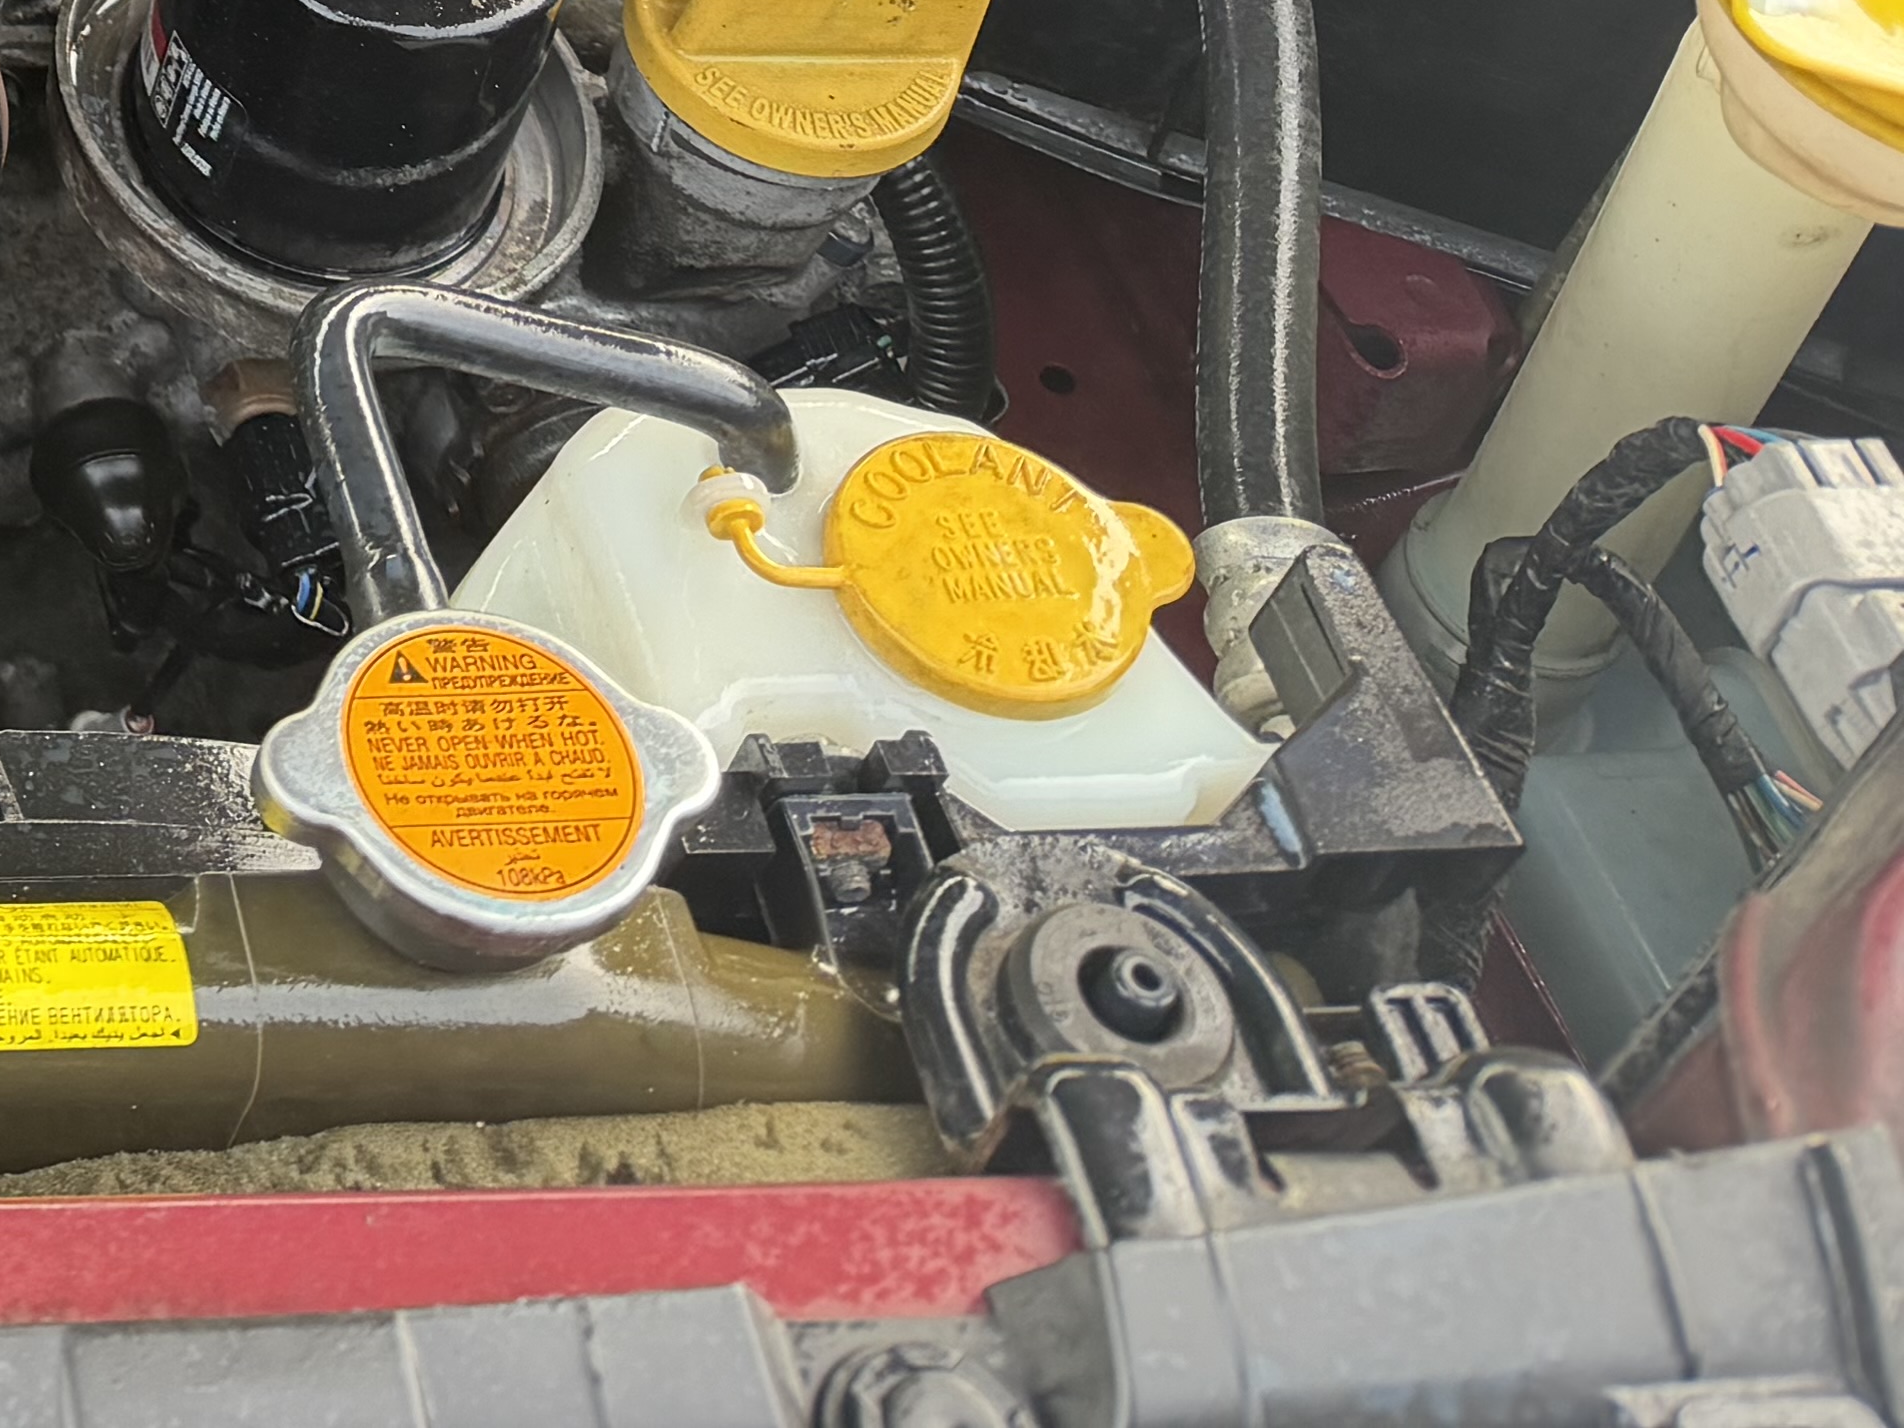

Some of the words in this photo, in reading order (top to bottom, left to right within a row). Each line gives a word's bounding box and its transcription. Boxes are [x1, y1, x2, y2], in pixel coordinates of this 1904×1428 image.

[693, 65, 749, 111] SEE
[750, 96, 872, 141] OWNER'S
[874, 69, 950, 133] MANUAL
[848, 441, 1081, 530] COOLANT
[935, 509, 1000, 540] SEE
[930, 534, 1062, 572] OWNERS
[940, 566, 1081, 604] MANUAL
[426, 637, 490, 655] 警告
[424, 652, 538, 674] WARNING
[366, 736, 428, 754] NEVER
[437, 735, 488, 753] OPEN
[494, 732, 554, 750] WHEN
[560, 729, 606, 747] HOT.
[373, 755, 396, 771] NE
[400, 753, 460, 771] JAMAIS
[464, 750, 525, 770] OUVRIR
[382, 792, 410, 807] Не
[430, 823, 602, 849] AVERTISSEMENT
[495, 865, 567, 888] 108kPa
[15, 946, 59, 965] ÉTANT
